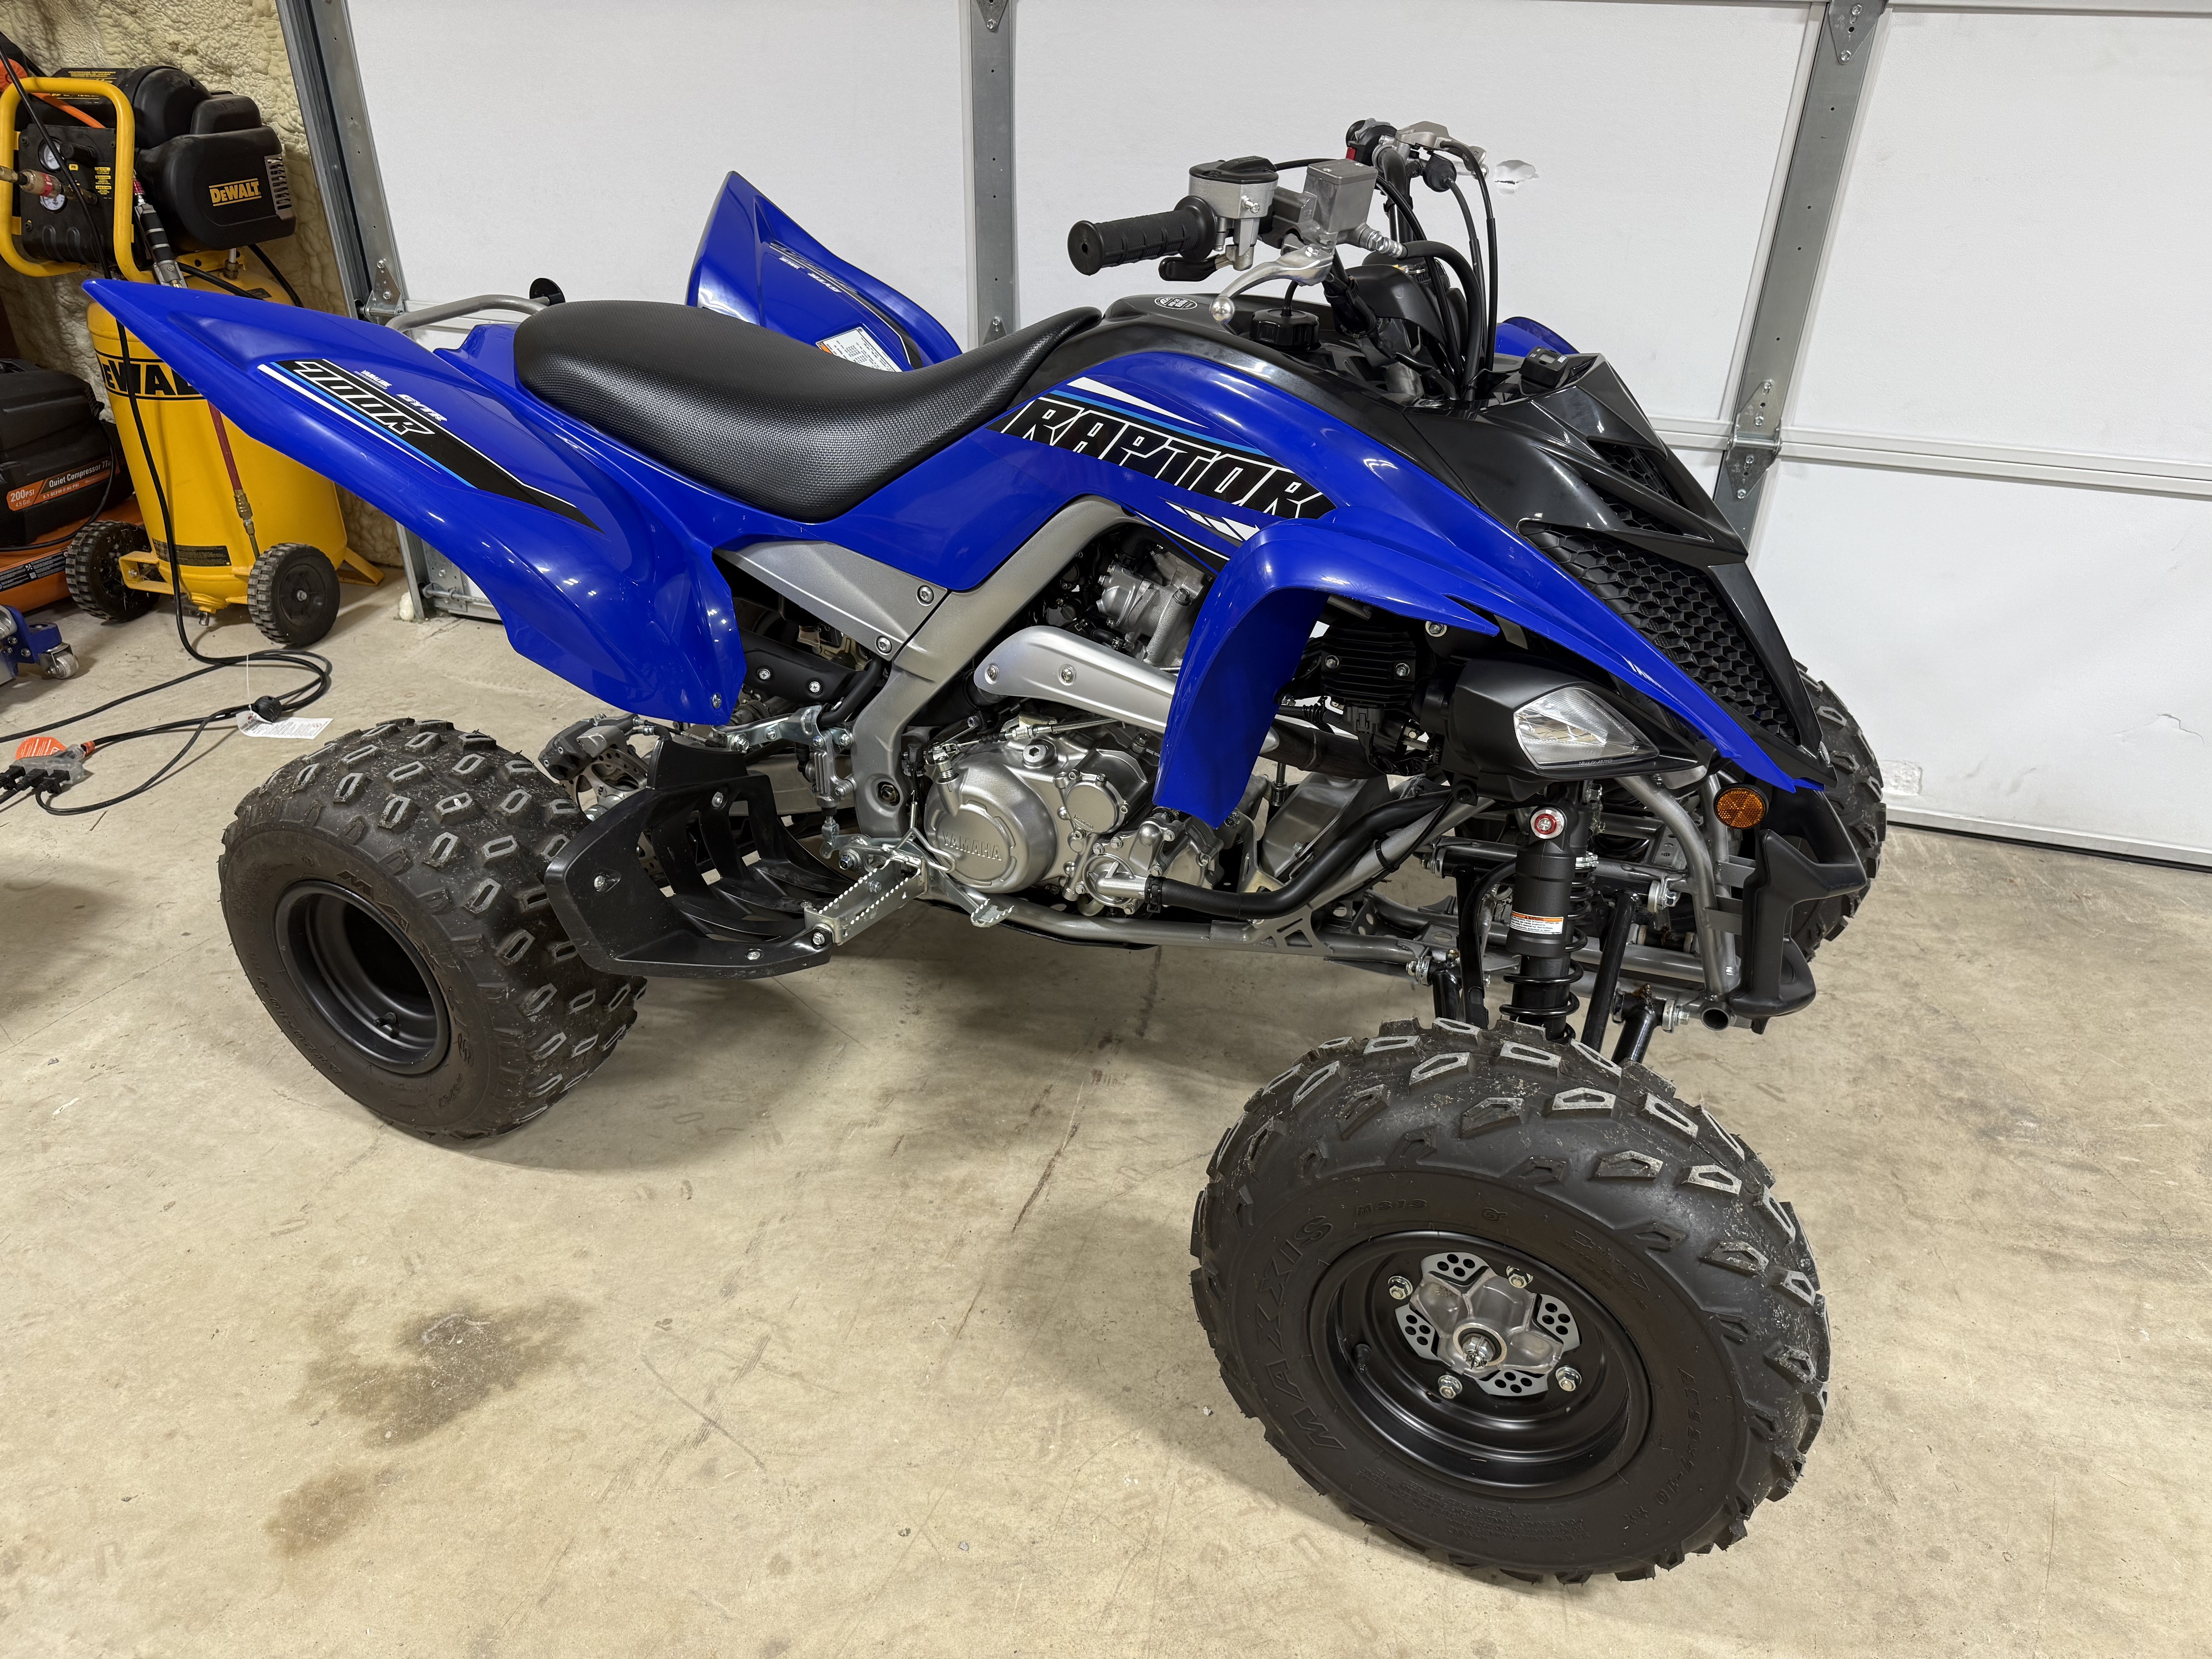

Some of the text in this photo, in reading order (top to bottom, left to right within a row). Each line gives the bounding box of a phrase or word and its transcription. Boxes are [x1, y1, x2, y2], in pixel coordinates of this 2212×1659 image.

[293, 361, 435, 436] 700R
[396, 394, 448, 422] GYTR
[49, 476, 66, 488] Quiet
[66, 464, 101, 481] Compressor
[1001, 397, 1325, 519] RAPTOR
[942, 831, 1002, 861] YAMAHA
[1356, 1198, 1428, 1216] MS13
[1255, 1215, 1346, 1451] MAXXIS
[1656, 1366, 1702, 1505] AT22x7-10
